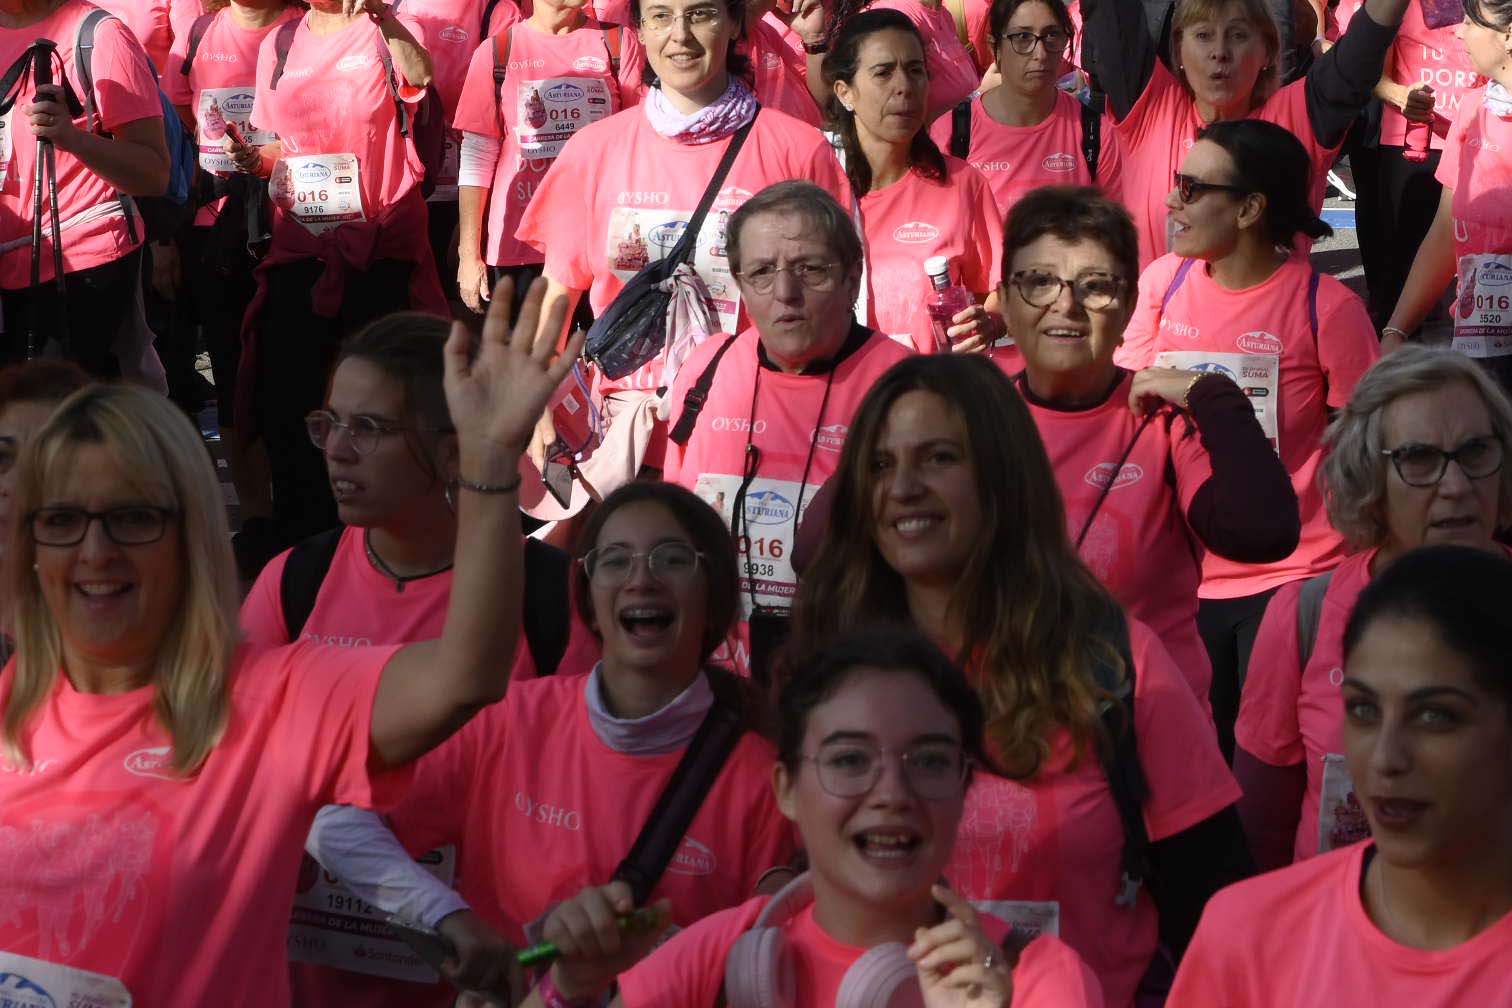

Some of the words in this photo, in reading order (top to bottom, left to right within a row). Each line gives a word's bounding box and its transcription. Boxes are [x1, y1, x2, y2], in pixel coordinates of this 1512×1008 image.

[549, 108, 581, 120] 016
[297, 190, 329, 203] 016
[304, 205, 324, 214] 9176
[1476, 294, 1510, 309] 016
[1241, 370, 1269, 378] SUMA
[711, 416, 767, 434] OYSHO
[756, 583, 766, 591] LA
[767, 584, 796, 593] MUJER
[514, 792, 581, 830] OYSHO
